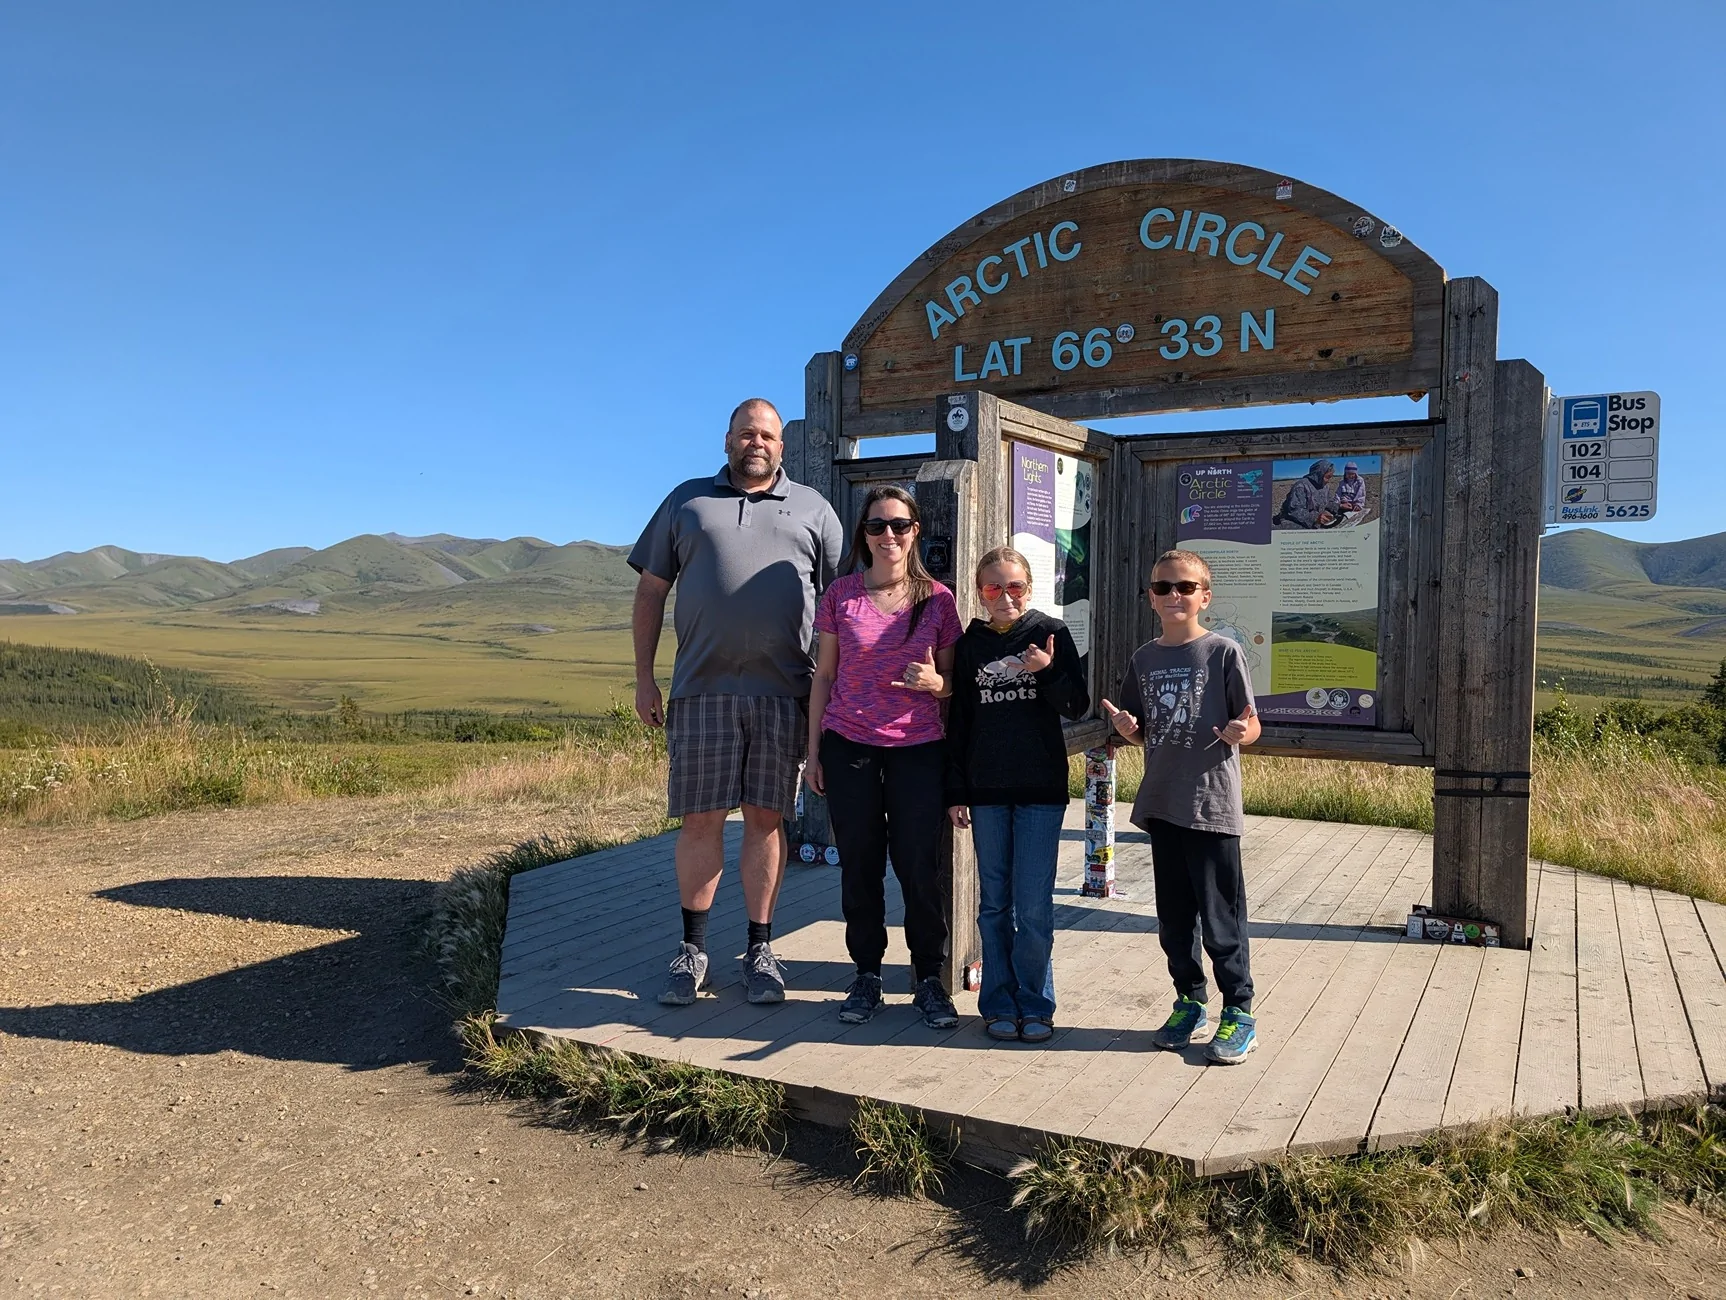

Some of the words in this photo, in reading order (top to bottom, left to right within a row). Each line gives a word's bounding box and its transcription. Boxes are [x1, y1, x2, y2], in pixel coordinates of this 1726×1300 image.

[925, 221, 1081, 340] ARCTIC
[1140, 207, 1332, 295] CIRCLE
[954, 337, 1031, 382] LAT
[1159, 315, 1223, 359] 33
[1240, 308, 1275, 352] N
[1608, 395, 1646, 411] Bus
[1608, 414, 1655, 433] Stop
[1569, 443, 1602, 458] 102
[1021, 455, 1049, 473] Northern
[1569, 465, 1601, 479] 104
[1023, 468, 1042, 484] Lights
[1190, 478, 1232, 489] Arctic
[1189, 489, 1227, 500] Circle
[1605, 505, 1650, 518] 5625
[980, 686, 1037, 704] Roots
